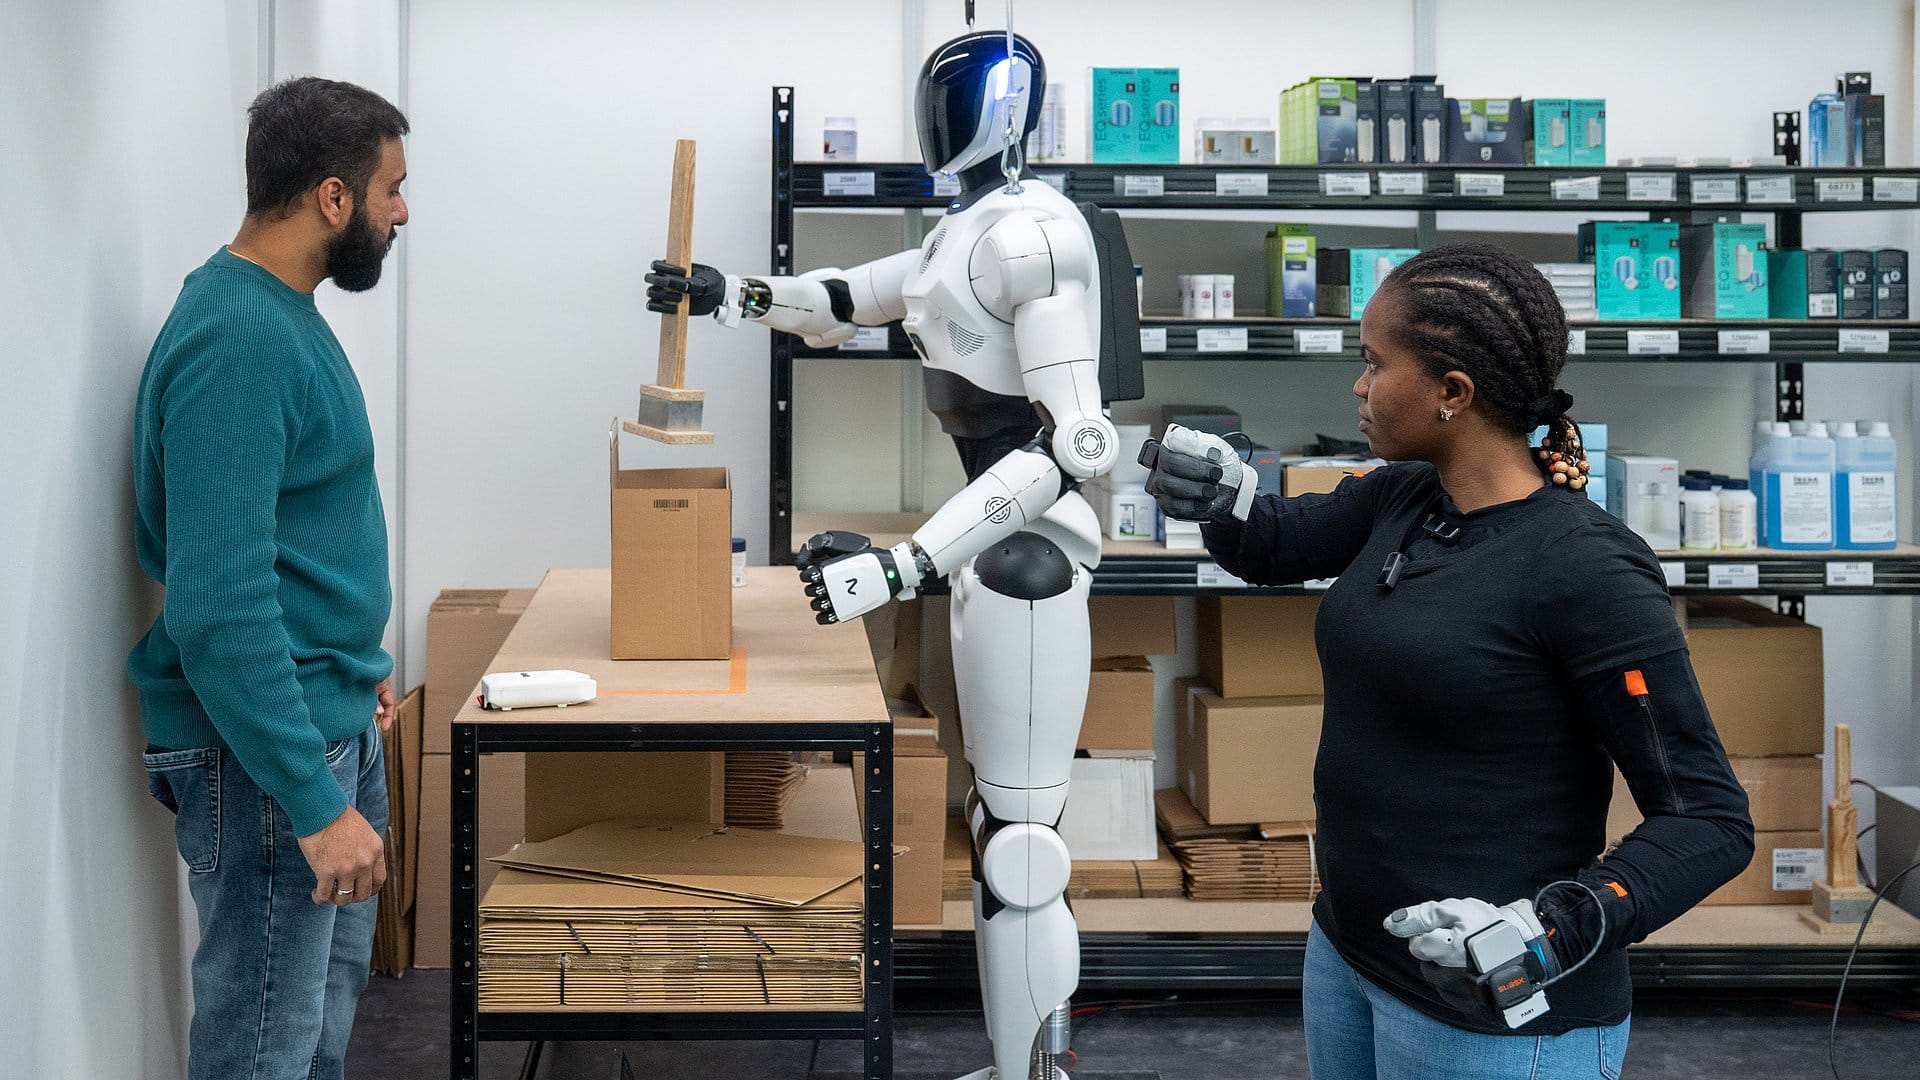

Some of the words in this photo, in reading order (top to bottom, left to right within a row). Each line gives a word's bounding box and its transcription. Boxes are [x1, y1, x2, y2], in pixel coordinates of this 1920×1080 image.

[1098, 78, 1106, 117] series
[1142, 78, 1151, 118] series
[1095, 121, 1107, 141] EQ
[1139, 121, 1151, 141] EQ
[1720, 227, 1730, 267] series
[1355, 253, 1363, 284] series
[1599, 270, 1610, 289] EQ
[1639, 270, 1650, 289] EQ
[1719, 270, 1730, 291] EQ
[1353, 286, 1364, 304] EQ
